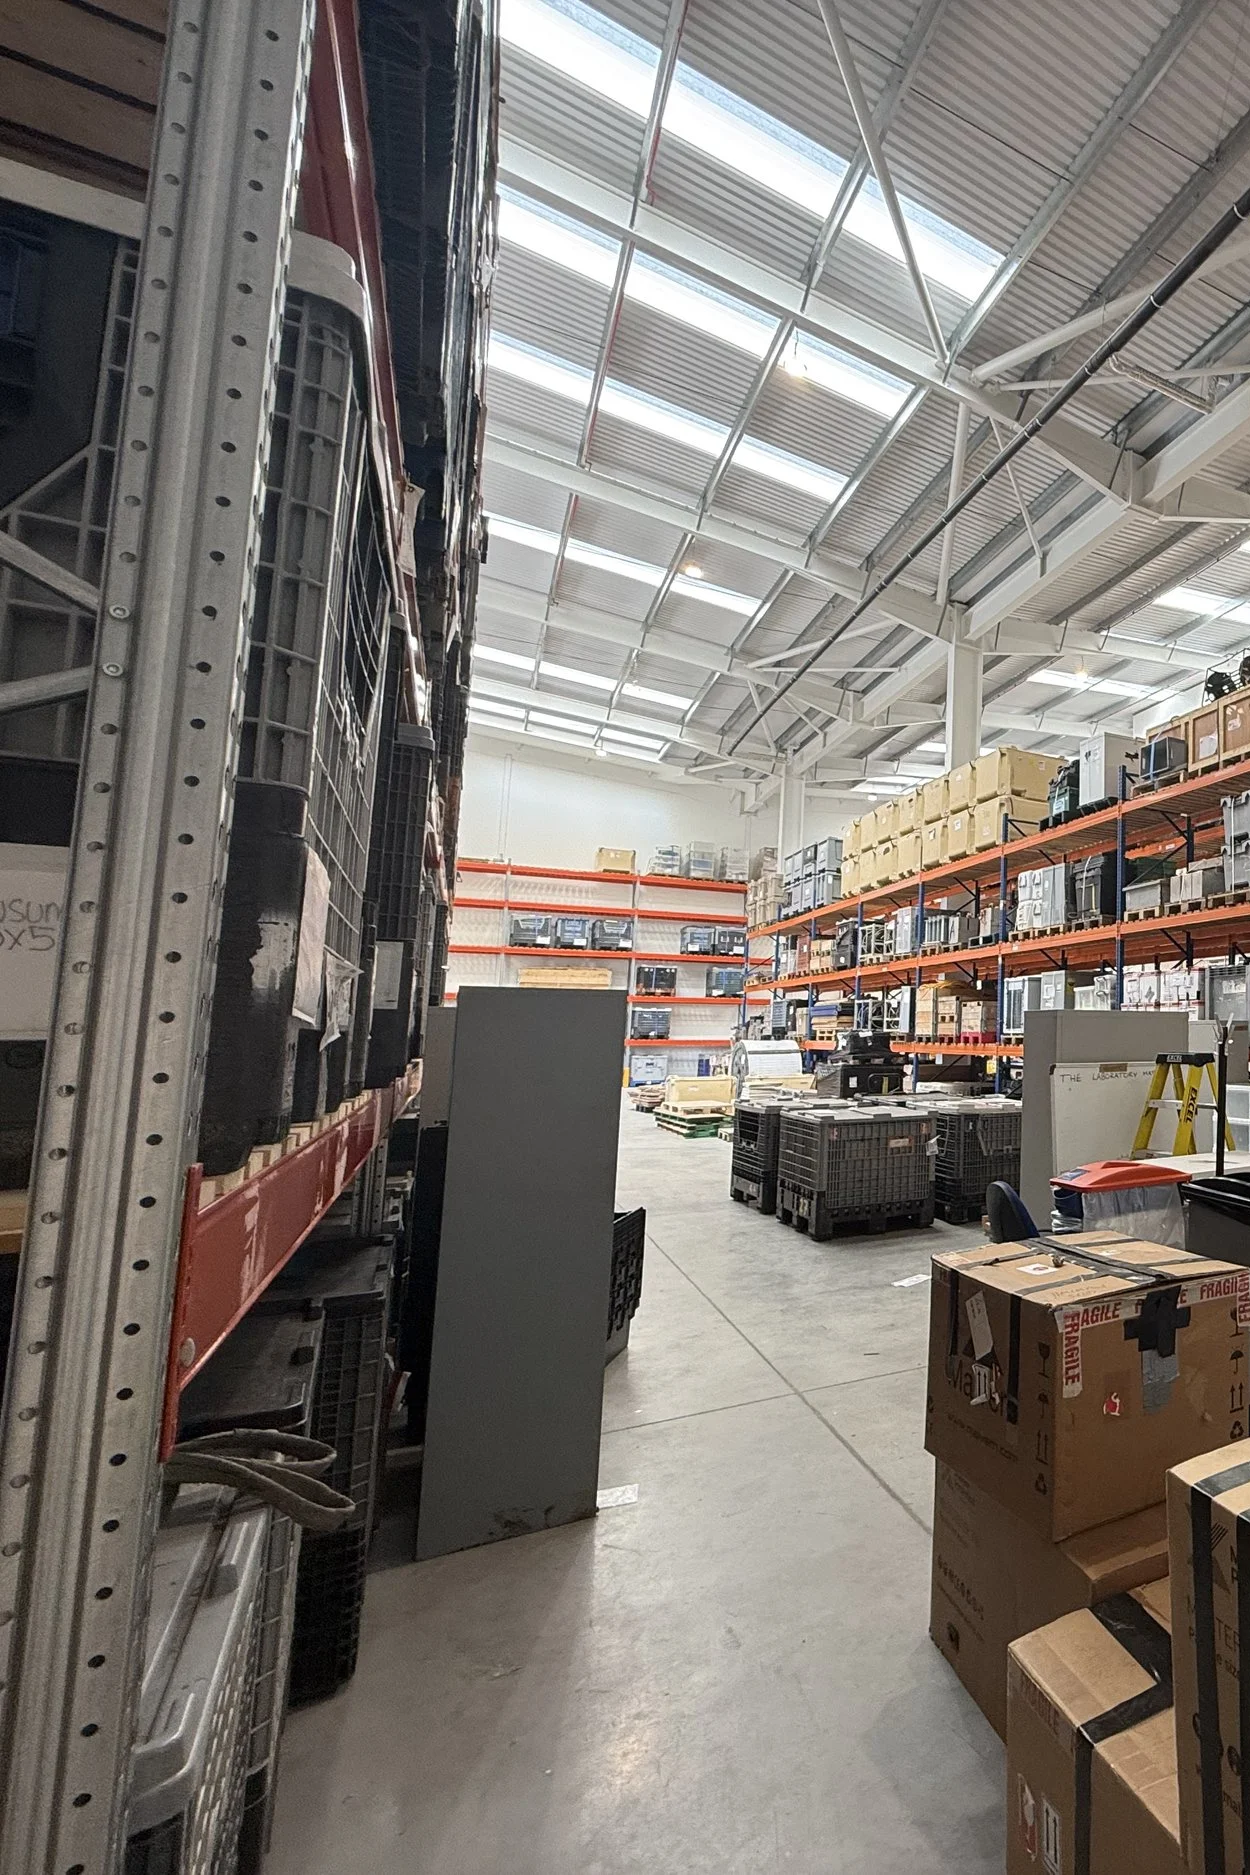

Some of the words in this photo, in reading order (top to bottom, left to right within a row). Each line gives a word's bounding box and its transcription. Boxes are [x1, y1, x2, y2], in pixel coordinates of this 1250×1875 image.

[1060, 1073, 1082, 1083] THE
[1092, 1071, 1138, 1081] LABORATORY
[1186, 1087, 1197, 1123] EXCEL
[1081, 1301, 1121, 1326] AGILE
[1064, 1310, 1080, 1386] FRAGILE
